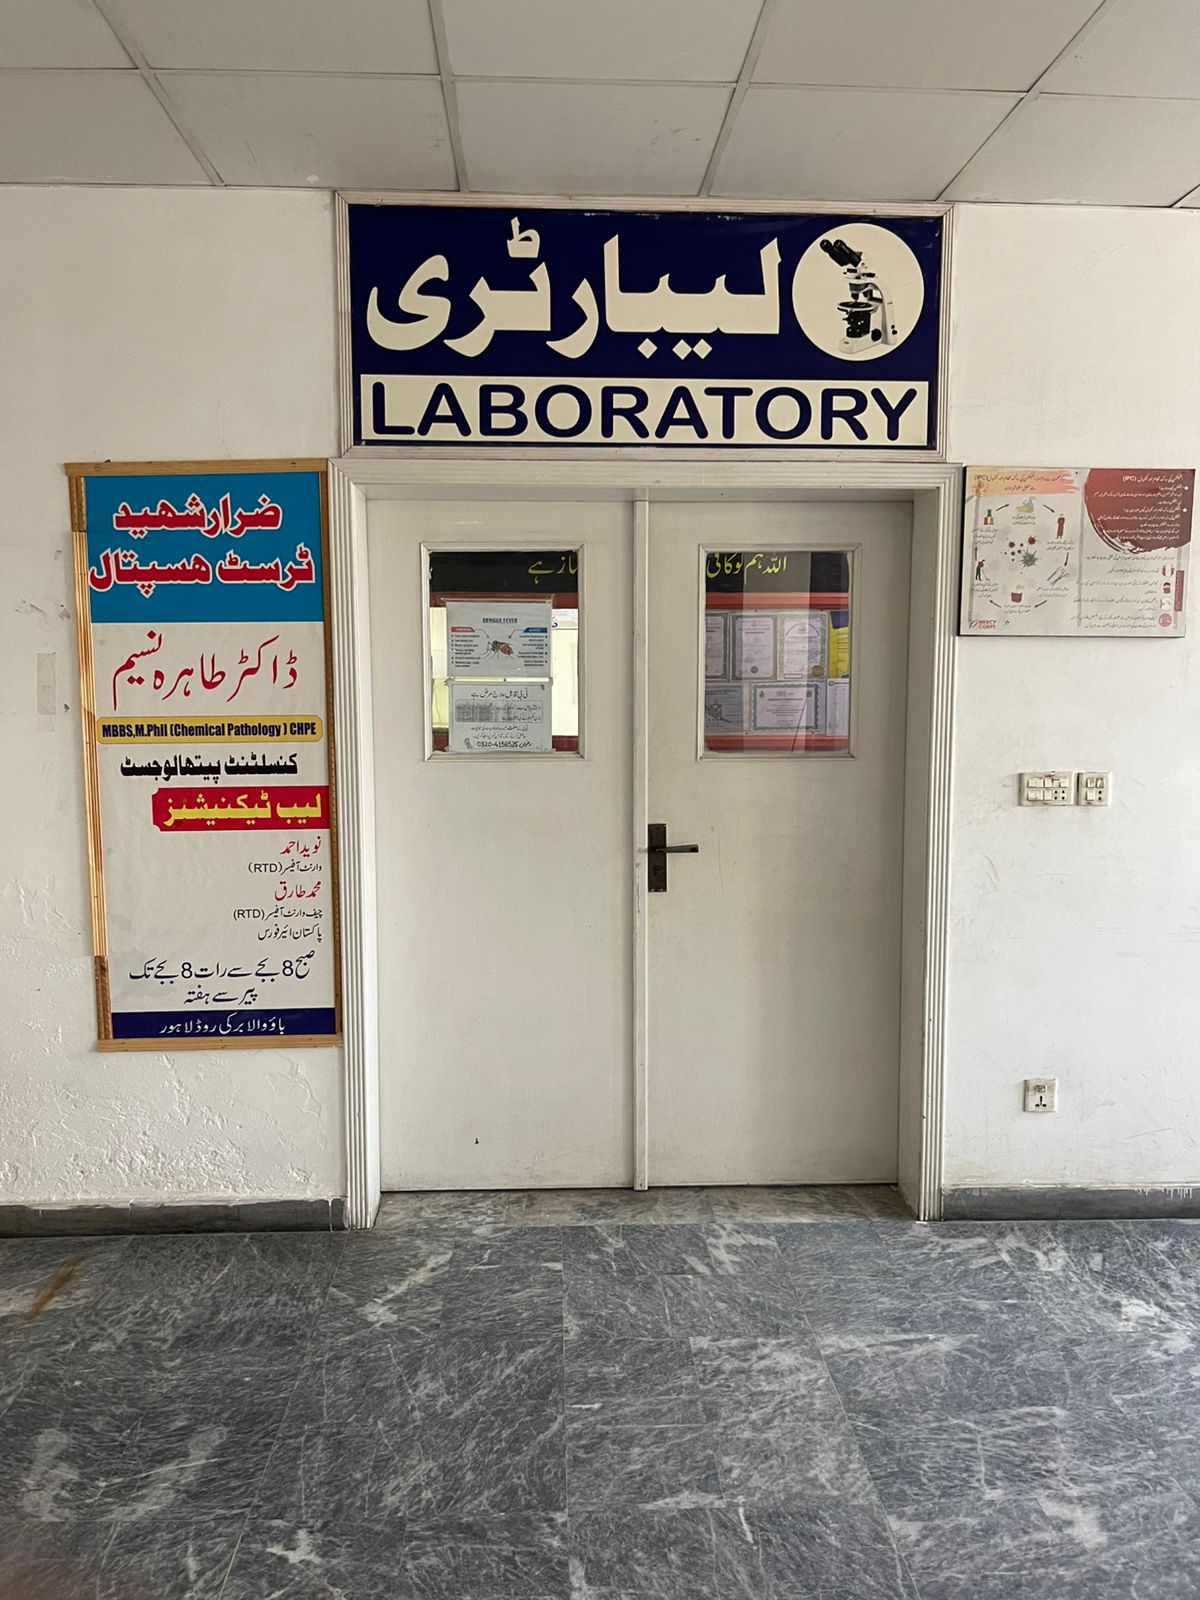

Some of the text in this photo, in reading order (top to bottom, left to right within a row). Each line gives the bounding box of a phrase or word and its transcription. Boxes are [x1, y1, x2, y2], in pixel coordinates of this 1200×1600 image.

[366, 216, 782, 360] لیبارٹری
[372, 381, 917, 442] LABORATORY
[203, 493, 282, 538] ضرار
[216, 542, 315, 591] ٹرسٹ
[113, 630, 298, 711] ڈاکٹر طاہرہ نسیم
[102, 724, 167, 739] MBBS,M.Phil
[170, 723, 225, 737] (Chemical
[227, 722, 281, 737] Pathology
[290, 722, 316, 735] CHPE
[120, 751, 298, 784] کنسلٹنٹ پیتھالوجسٹ
[276, 793, 321, 825] لیب
[280, 836, 321, 857] نوید احمد
[248, 859, 322, 875] وارنٹ آفیسر (RTD)
[275, 881, 321, 901] محمد طارق
[233, 909, 265, 920] (RTD)
[264, 905, 284, 921] آفیسر
[305, 908, 322, 918] چیف
[292, 923, 322, 943] پاکستان
[129, 950, 315, 985] صبح 8 بجے سے رات 8 بجے تک
[183, 984, 258, 1006] پیر سے ہفتہ
[159, 1018, 194, 1035] لاہور
[195, 1017, 215, 1033] روڈ
